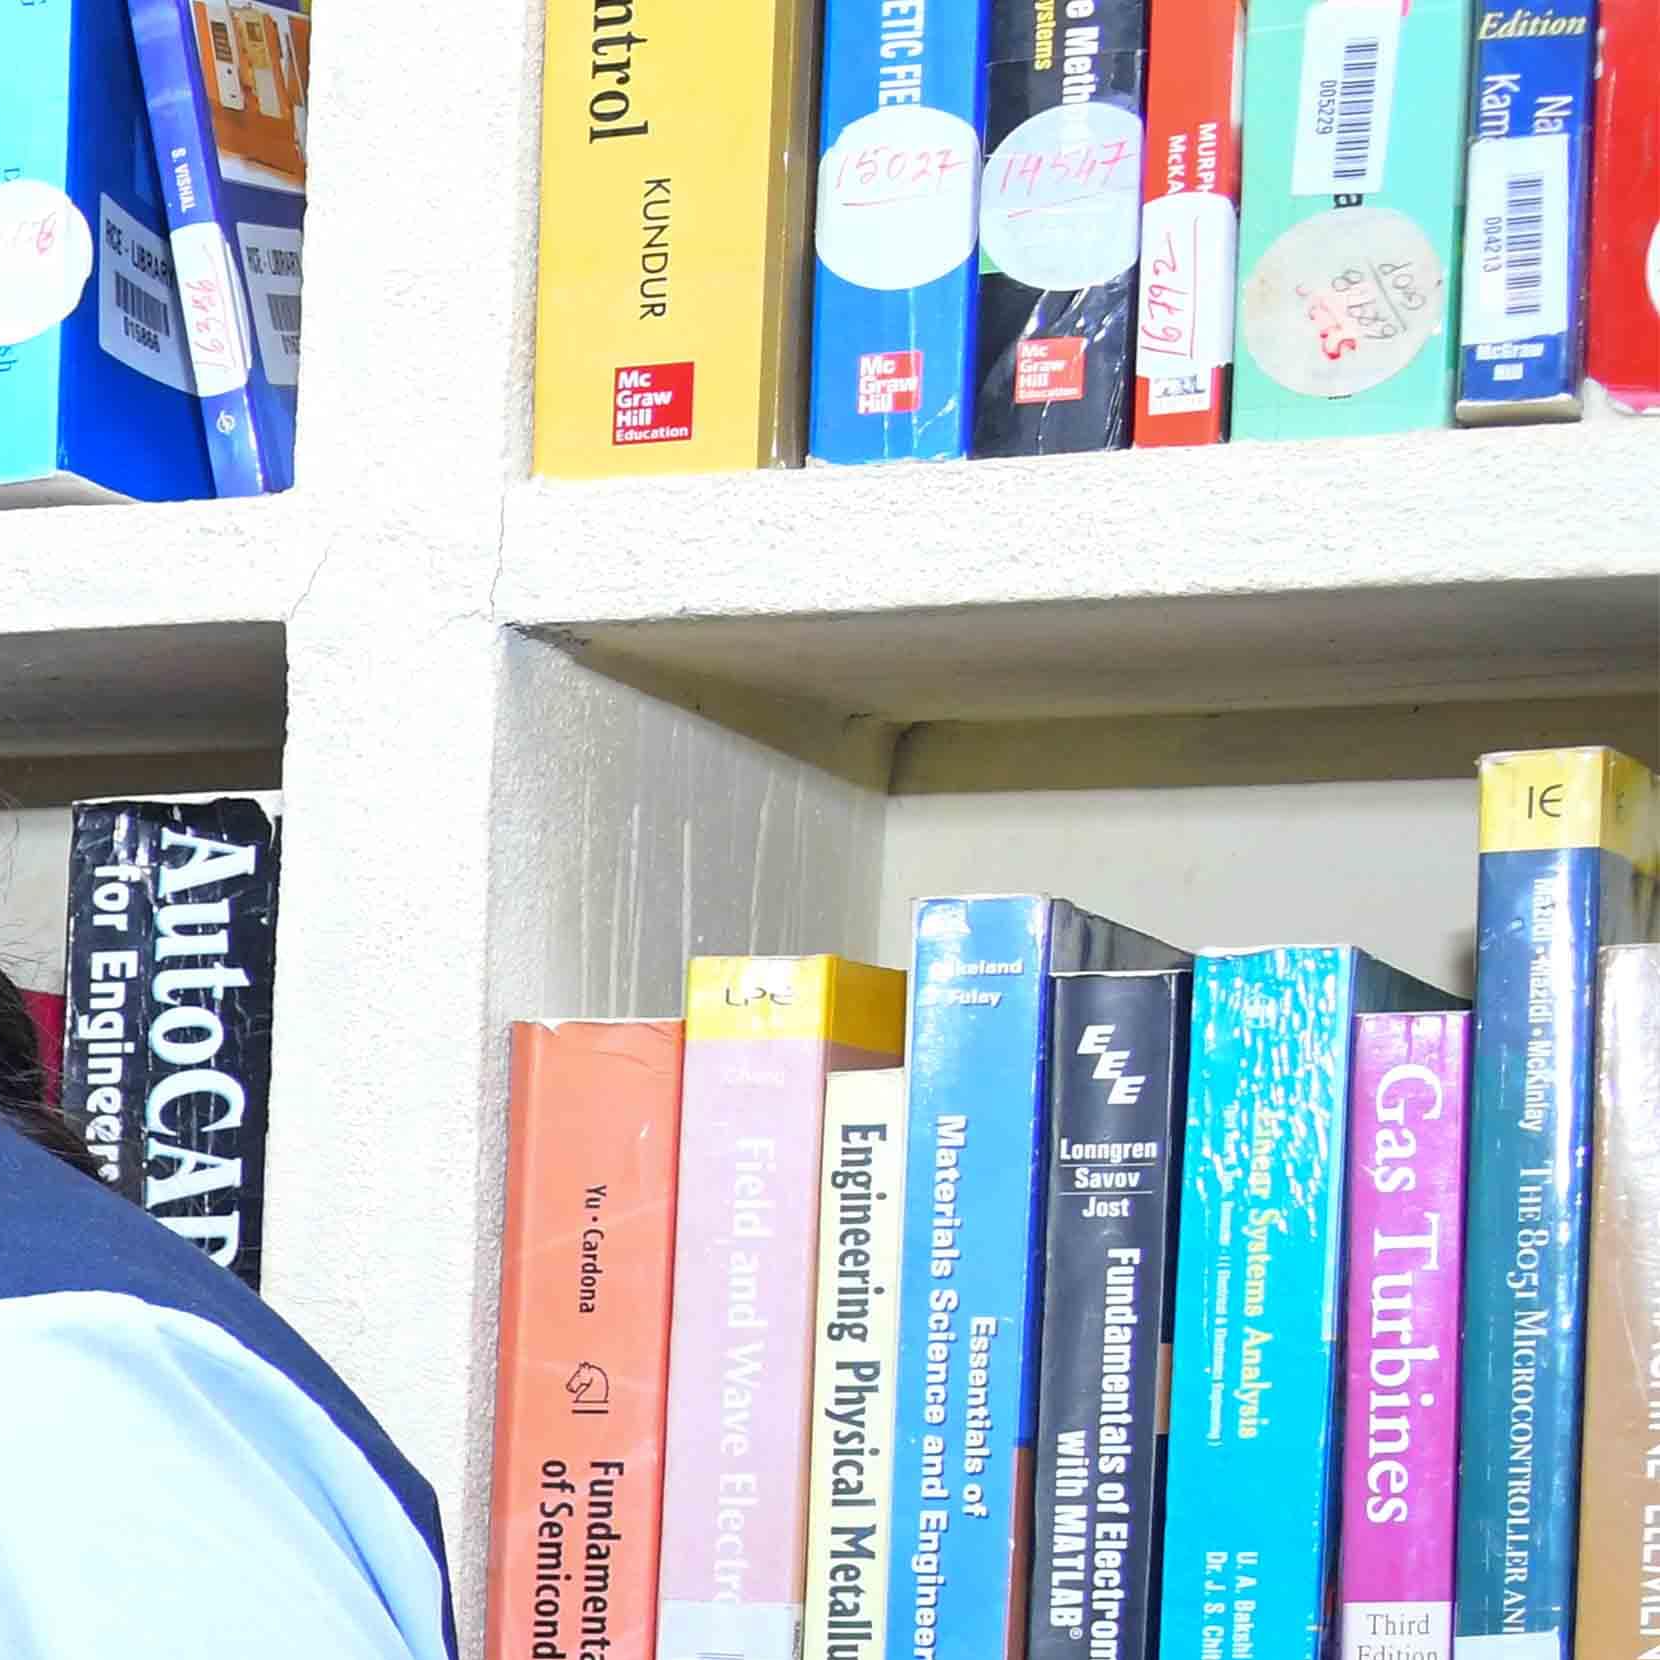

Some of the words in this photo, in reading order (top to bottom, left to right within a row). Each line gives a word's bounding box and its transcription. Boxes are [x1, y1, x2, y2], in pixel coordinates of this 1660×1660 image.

[1478, 11, 1586, 40] Edition
[1317, 80, 1337, 136] 005229
[640, 178, 671, 320] KUNDUR
[1483, 217, 1502, 273] 004213
[616, 389, 672, 410] Graw
[615, 424, 688, 443] Education
[1059, 1138, 1159, 1162] Lonngren
[1373, 1064, 1442, 1192] Gas
[583, 1184, 607, 1210] Yu
[732, 1138, 775, 1239] Field
[929, 1114, 968, 1279] Materials
[1074, 1167, 1140, 1189] Savov
[1081, 1196, 1130, 1218] Jost
[827, 1123, 887, 1342] Engineering
[579, 1230, 605, 1313] Cardona
[725, 1251, 768, 1328] and
[923, 1289, 960, 1425] Science
[1366, 1212, 1440, 1524] Turbines
[717, 1345, 765, 1457] Wave
[964, 1316, 997, 1471] Essentials
[822, 1362, 881, 1522] Physical
[918, 1434, 946, 1498] and
[542, 1460, 569, 1494] of
[961, 1481, 987, 1518] of
[1368, 1614, 1431, 1637] Third
